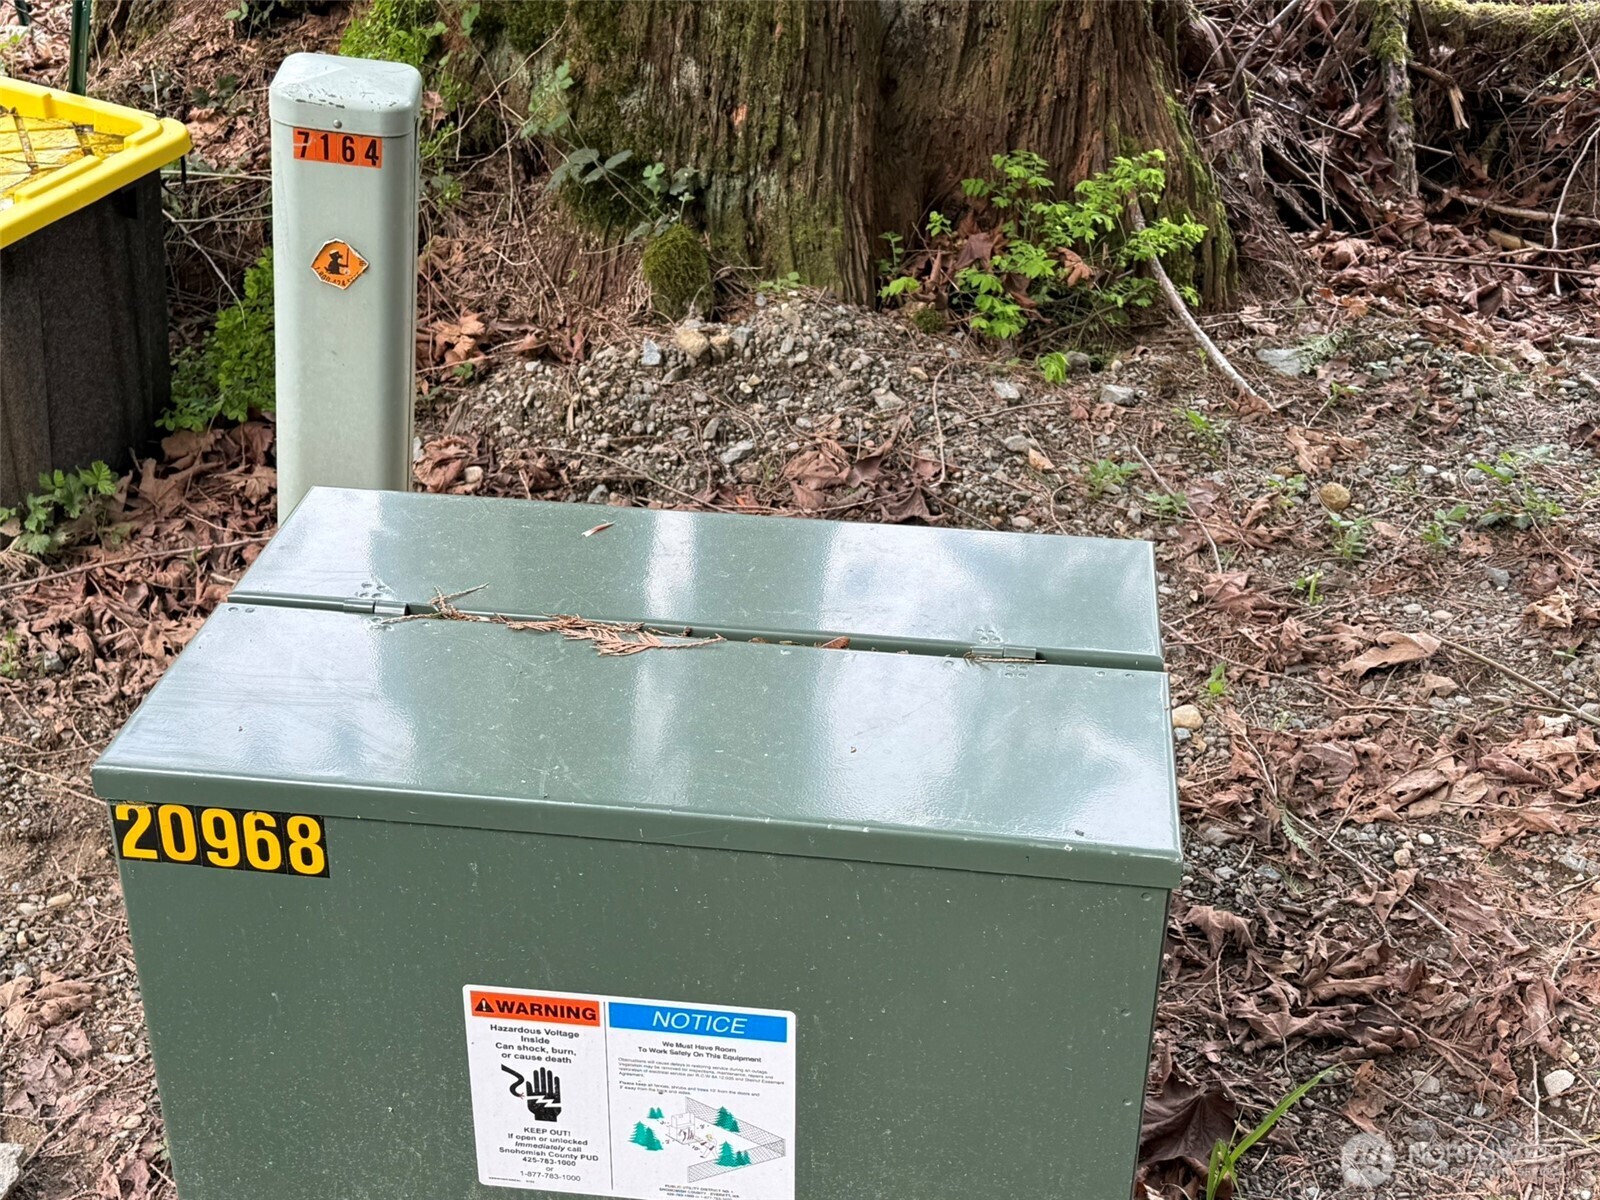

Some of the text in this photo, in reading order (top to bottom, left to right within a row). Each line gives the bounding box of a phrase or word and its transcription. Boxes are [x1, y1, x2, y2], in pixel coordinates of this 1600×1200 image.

[297, 130, 379, 166] 7164
[115, 803, 325, 875] 20968
[495, 999, 597, 1021] WARNING
[652, 1010, 748, 1035] NOTICE
[490, 1024, 580, 1039] Hazardous Voltage
[520, 1035, 550, 1045] Inside
[495, 1042, 577, 1057] Can shock, burn,
[675, 1042, 694, 1050] Must
[695, 1044, 713, 1052] Have
[715, 1045, 737, 1053] Room
[514, 1053, 542, 1061] cause
[545, 1055, 572, 1064] death
[649, 1047, 668, 1055] Work
[669, 1049, 692, 1057] Safely
[706, 1052, 721, 1060] This
[722, 1053, 762, 1063] Equipment
[523, 1126, 571, 1137] KEEP OUT!
[515, 1134, 537, 1142] open
[549, 1137, 588, 1146] unlocked
[515, 1141, 565, 1152] Immediately
[499, 1146, 546, 1157] Snohomish
[548, 1150, 578, 1160] County
[522, 1156, 577, 1167] 425-783-1000
[520, 1170, 581, 1182] 1-877-783-1000
